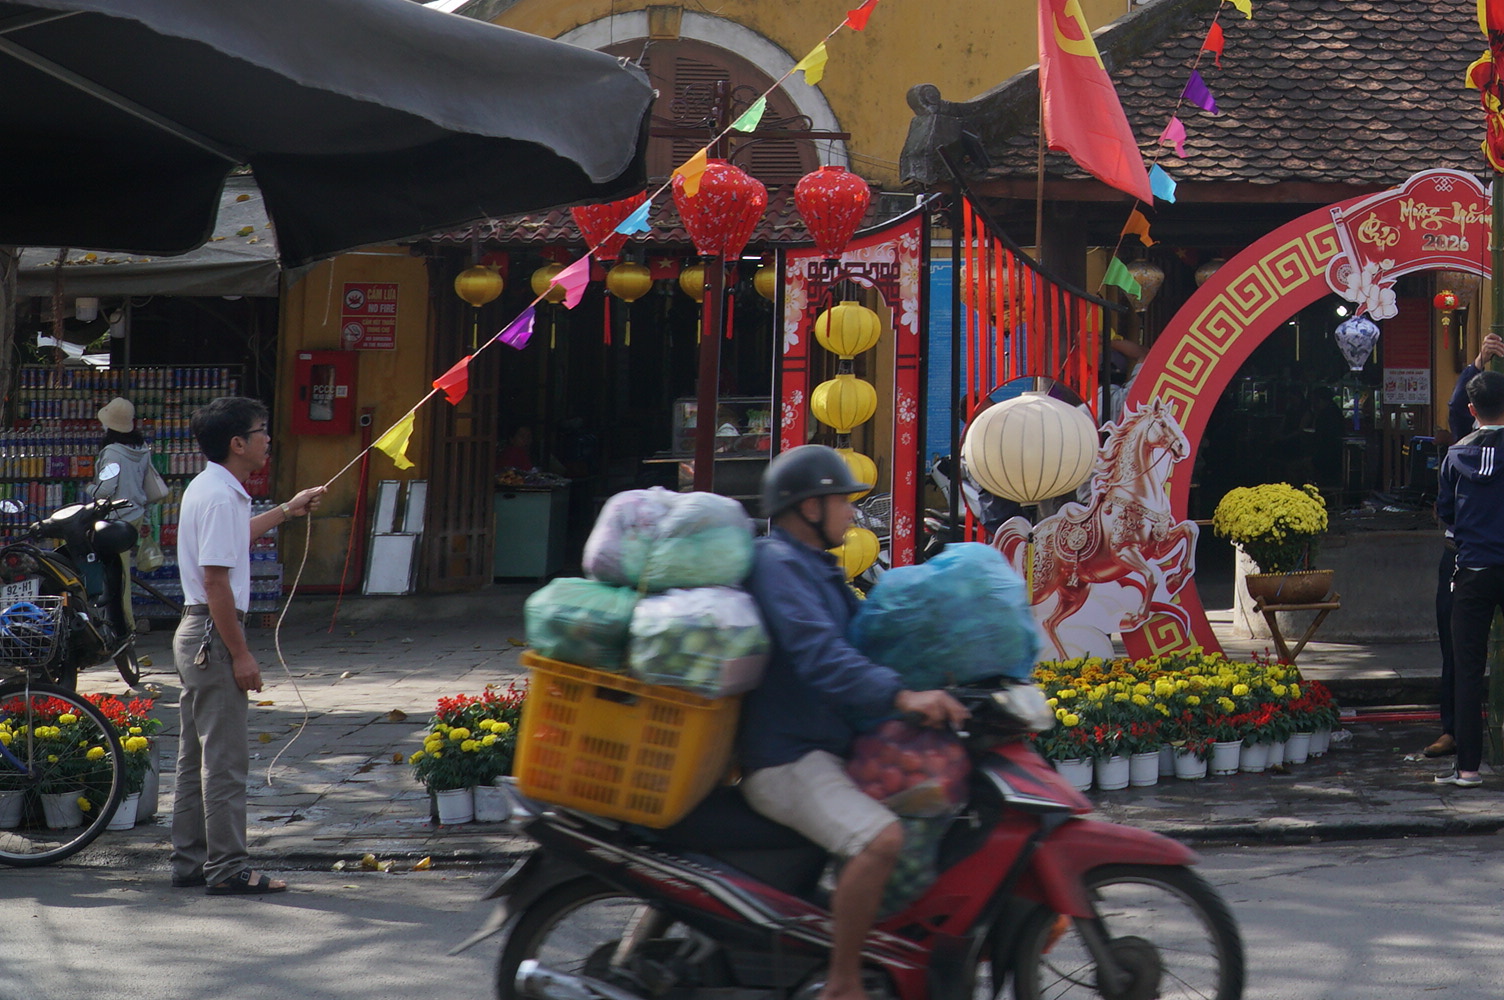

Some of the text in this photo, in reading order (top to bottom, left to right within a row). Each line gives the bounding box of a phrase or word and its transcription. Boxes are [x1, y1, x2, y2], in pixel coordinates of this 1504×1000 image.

[1421, 233, 1470, 252] 2026
[367, 303, 396, 313] NO FIRE
[313, 384, 336, 395] PCCC
[7, 581, 32, 595] 92-H1
